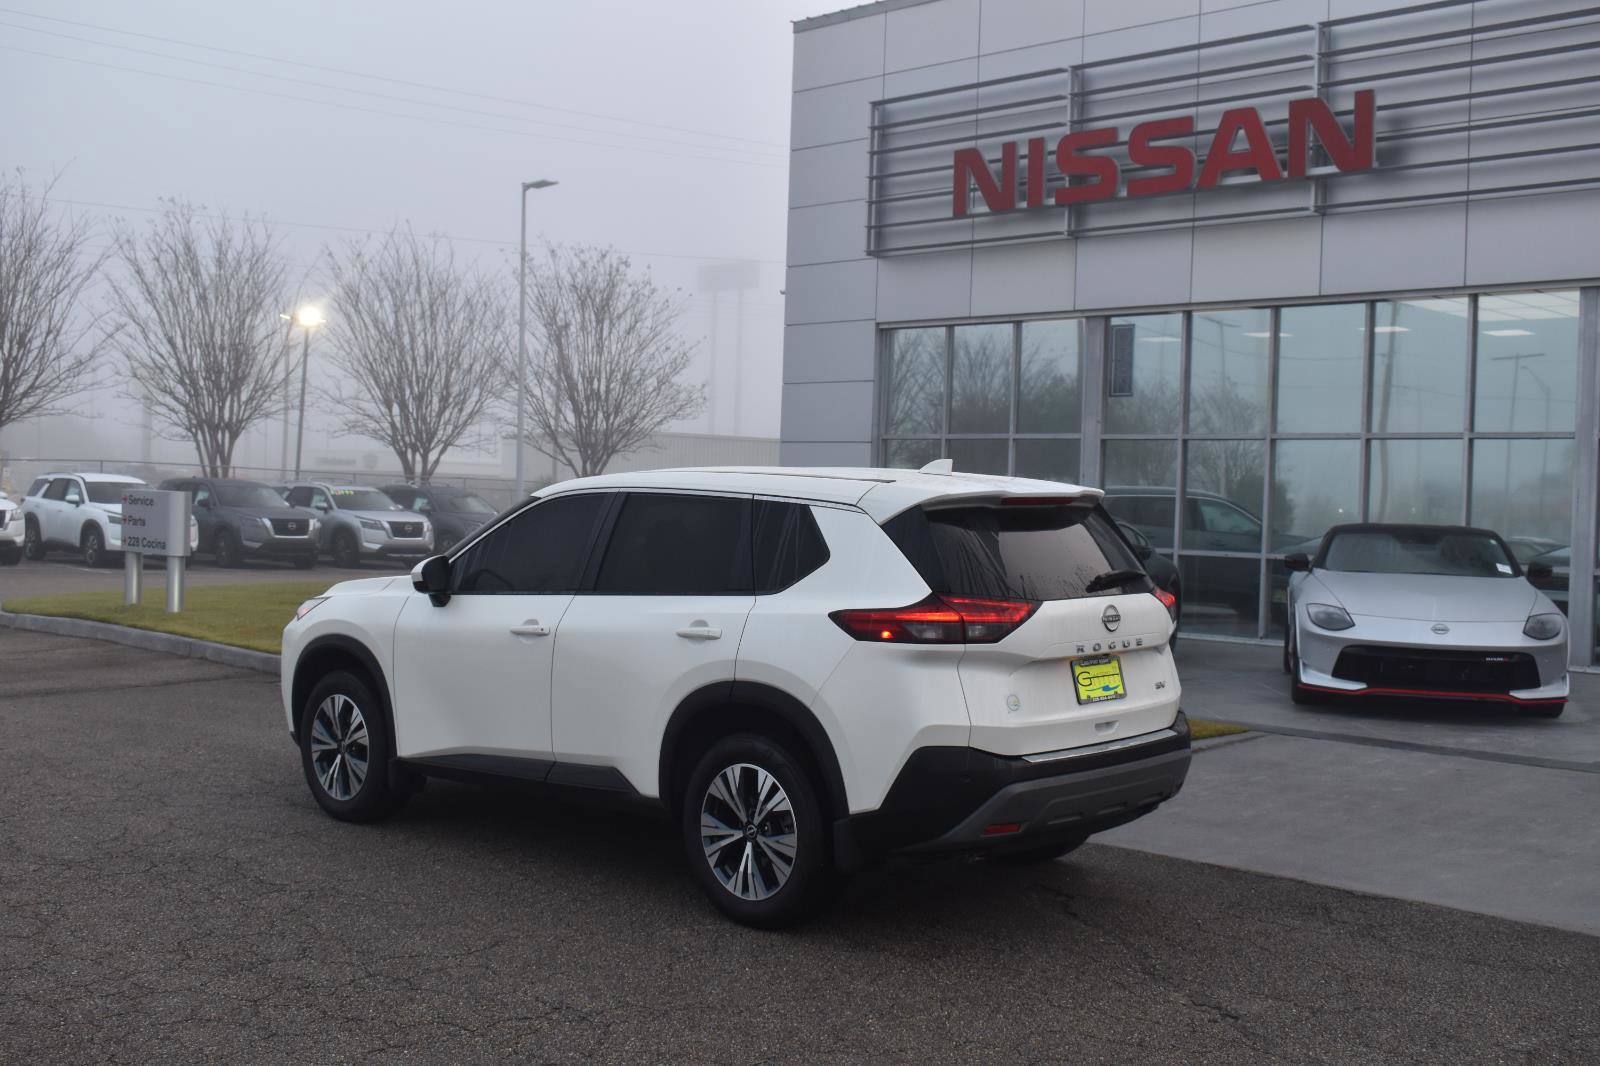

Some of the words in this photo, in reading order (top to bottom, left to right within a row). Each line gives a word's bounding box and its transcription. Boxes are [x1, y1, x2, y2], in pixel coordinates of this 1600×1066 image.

[953, 89, 1376, 218] NISSAN
[128, 494, 154, 507] Service
[128, 515, 146, 527] Parts
[128, 535, 140, 548] 228
[141, 536, 166, 550] Cocina
[1076, 638, 1143, 653] ROGUE
